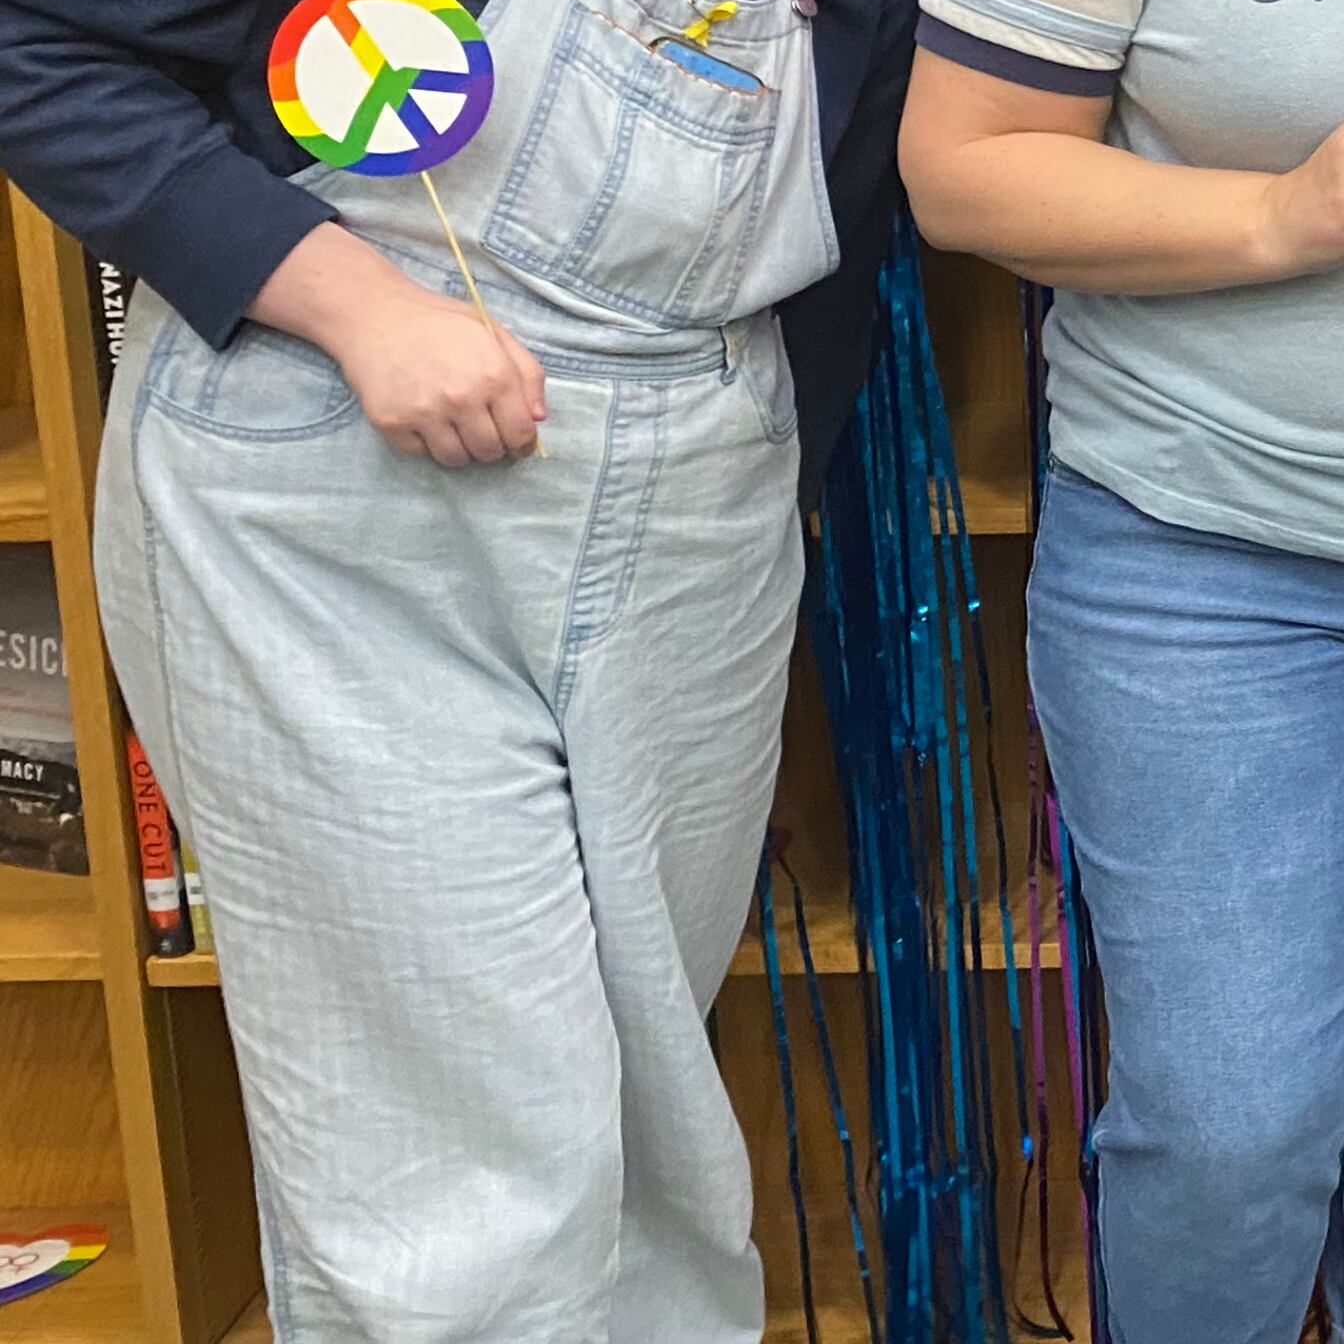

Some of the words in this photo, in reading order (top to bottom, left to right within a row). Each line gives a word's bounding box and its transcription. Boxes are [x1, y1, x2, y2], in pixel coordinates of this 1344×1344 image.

[99, 262, 125, 318] NAZI
[133, 760, 157, 814] ONE
[140, 821, 167, 875] CUT
